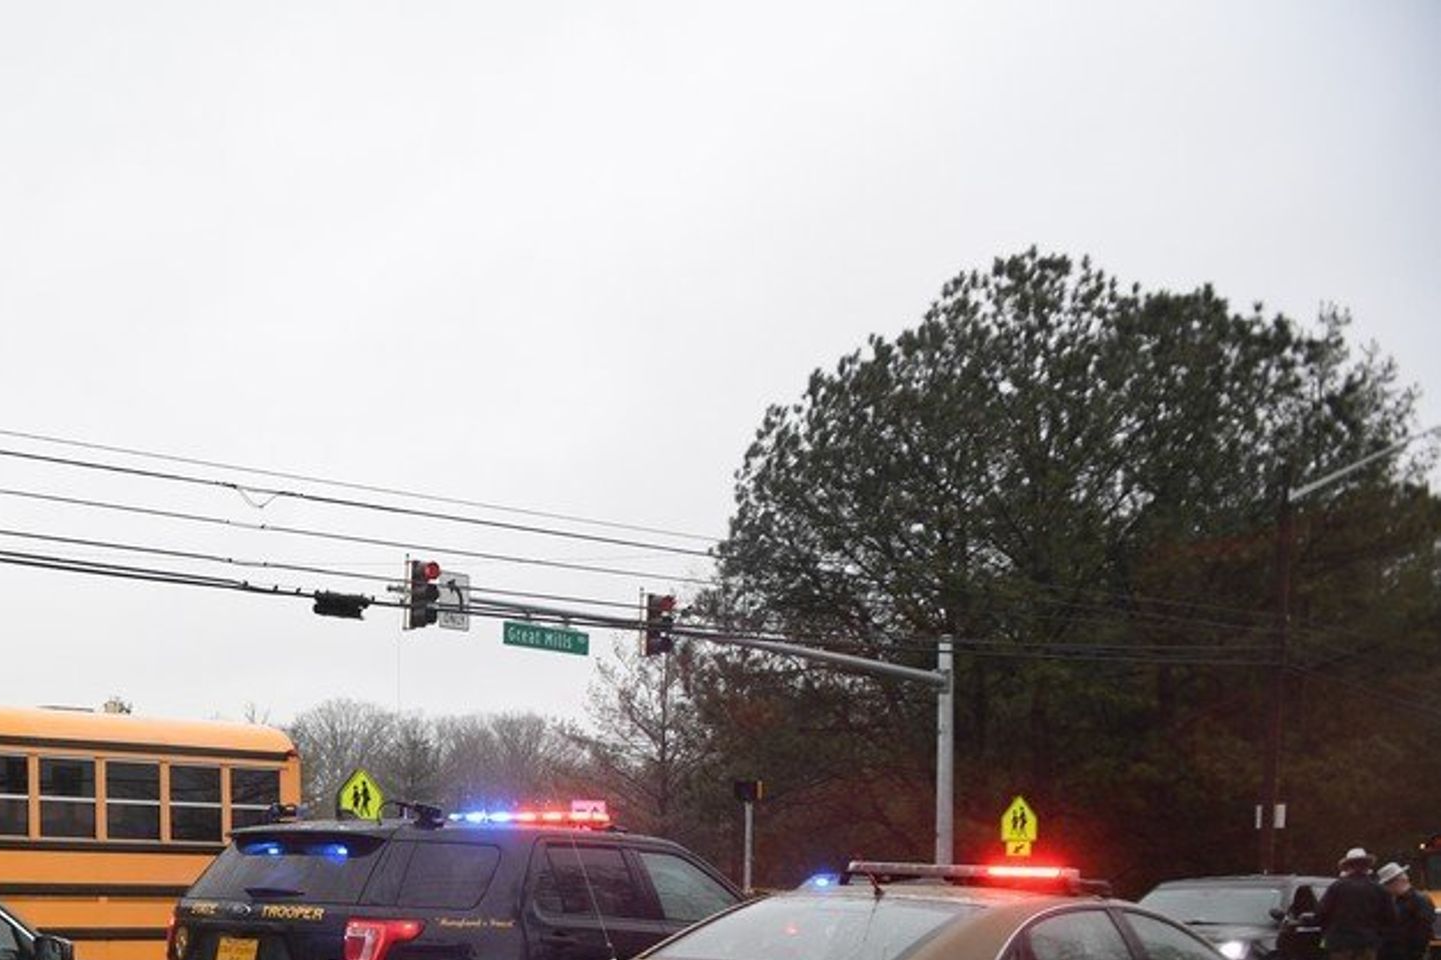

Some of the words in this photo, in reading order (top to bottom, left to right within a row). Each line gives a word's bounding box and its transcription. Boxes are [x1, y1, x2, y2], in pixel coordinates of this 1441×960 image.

[508, 627, 541, 645] Great
[544, 632, 572, 649] Mills
[262, 904, 325, 921] TROOPER
